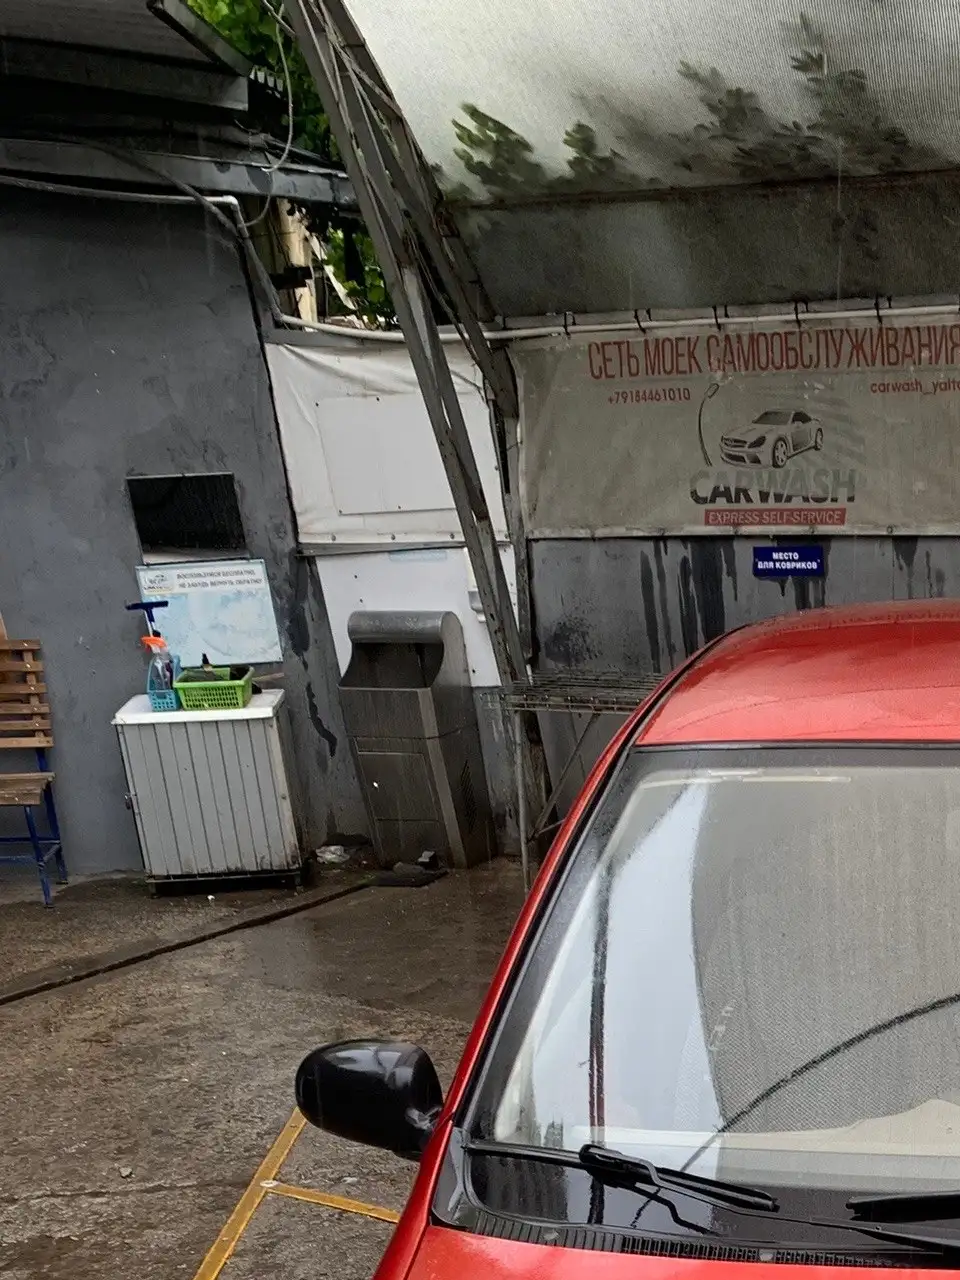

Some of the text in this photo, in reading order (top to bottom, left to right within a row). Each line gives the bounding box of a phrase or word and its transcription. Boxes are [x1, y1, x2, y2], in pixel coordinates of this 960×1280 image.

[588, 340, 640, 380] СЕТЬ
[644, 335, 702, 377] МОЕК
[608, 387, 691, 404] +79184461010
[689, 468, 858, 505] CARWASH
[708, 510, 842, 525] EXPRESS SELF-SERVICE
[772, 552, 799, 560] МЕСТО
[775, 561, 818, 569] КОВРИКОВ
